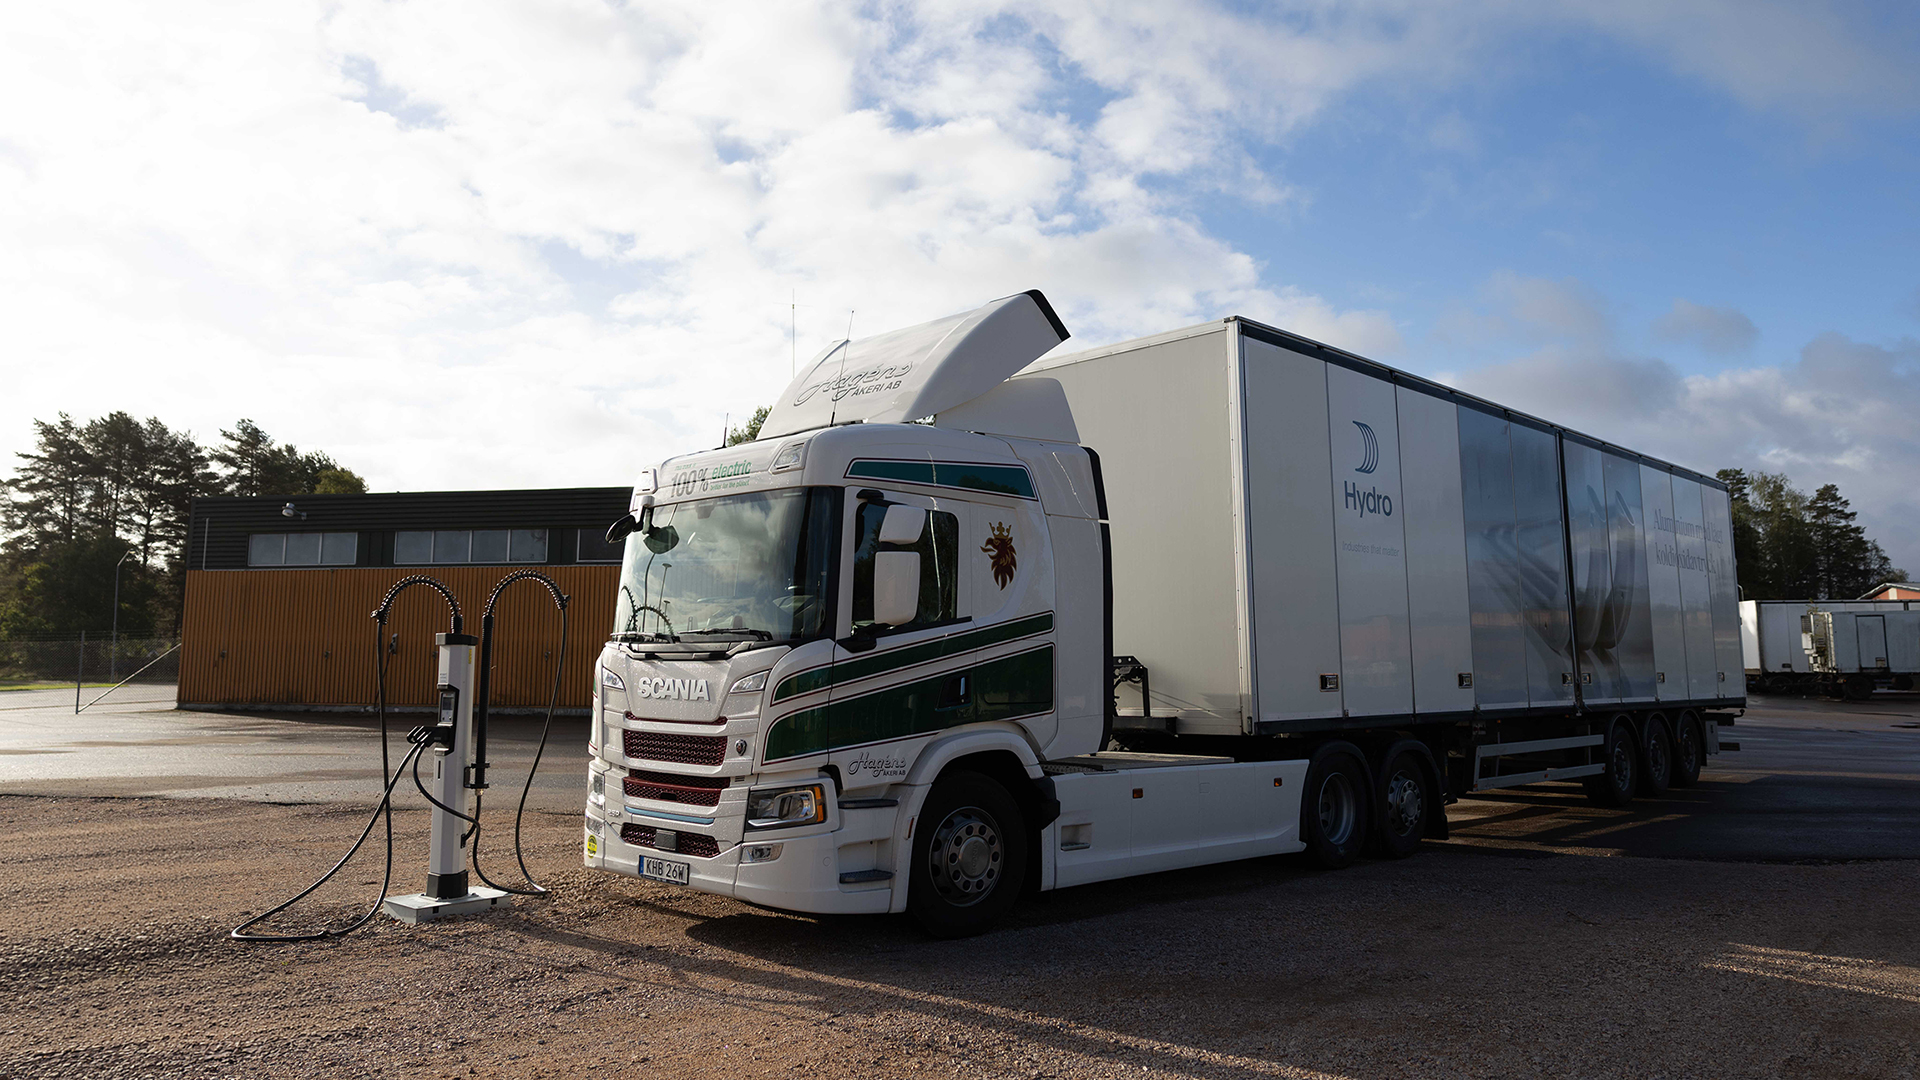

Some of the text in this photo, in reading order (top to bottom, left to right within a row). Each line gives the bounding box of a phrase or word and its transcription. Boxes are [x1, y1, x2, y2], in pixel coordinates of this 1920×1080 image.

[885, 380, 902, 391] AB
[671, 460, 752, 498] 100% electric
[1344, 481, 1393, 518] Hydro
[1654, 508, 1695, 537] Aluminium
[1342, 541, 1400, 557] Industries that matter
[637, 676, 710, 702] SCANIA
[847, 752, 907, 777] Hagéns
[646, 859, 663, 876] KHB
[666, 863, 685, 880] 26W
